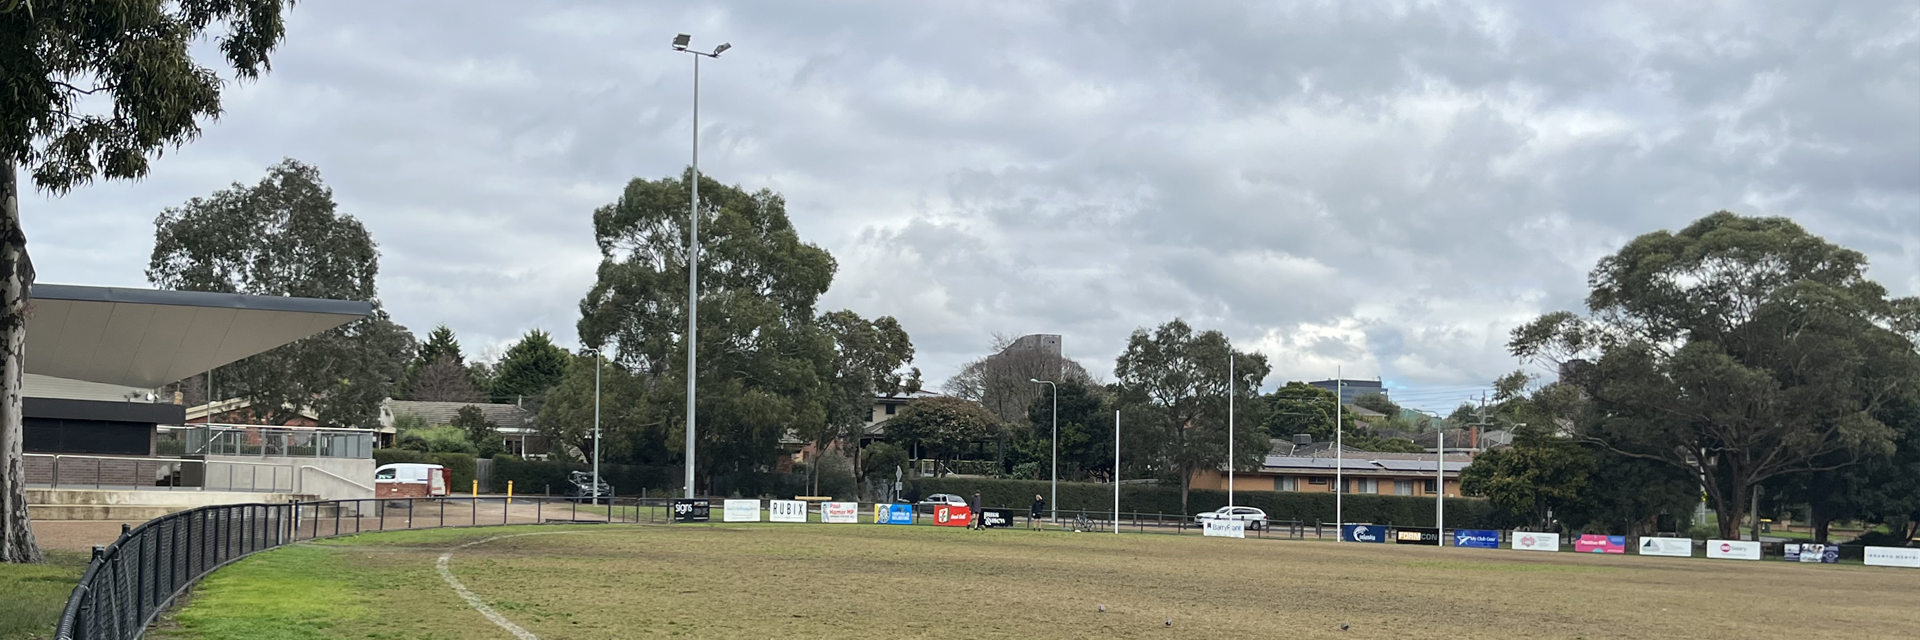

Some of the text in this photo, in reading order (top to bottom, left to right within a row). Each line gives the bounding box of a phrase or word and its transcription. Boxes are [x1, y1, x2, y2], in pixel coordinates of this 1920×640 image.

[675, 501, 693, 515] signs
[773, 502, 803, 515] RUBIX
[1213, 524, 1242, 532] BarryPant
[1398, 531, 1438, 541] FORMCON
